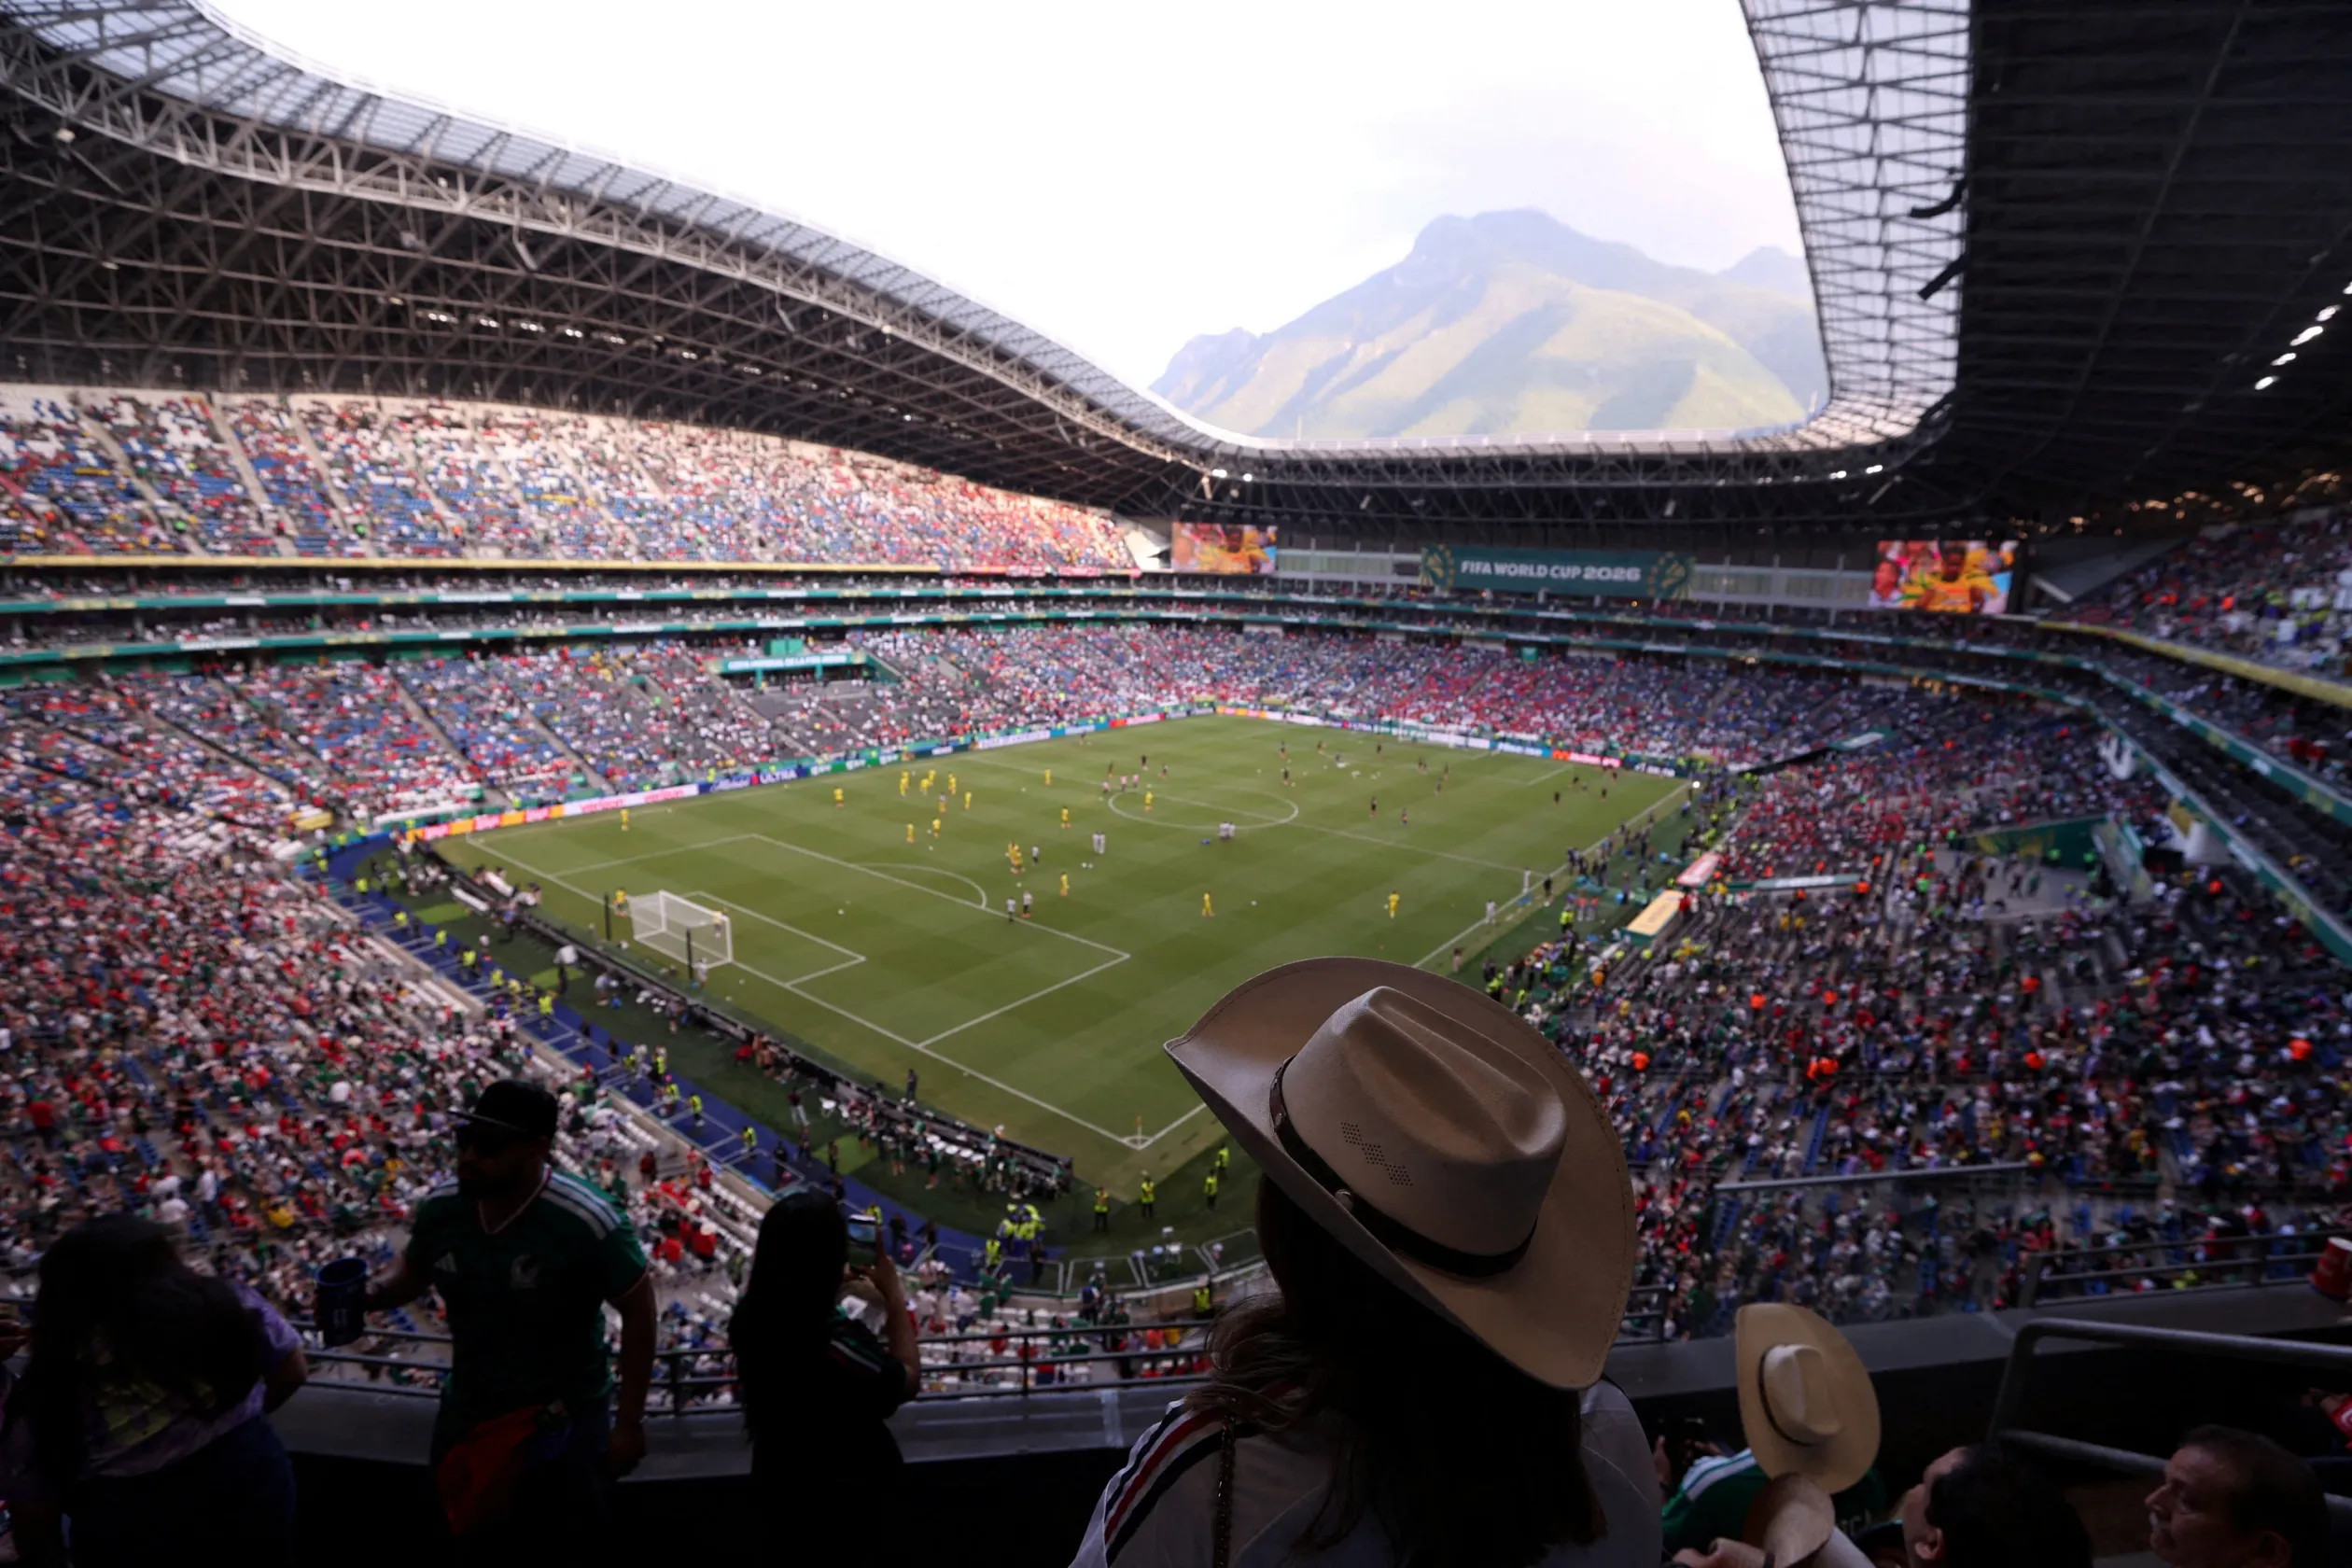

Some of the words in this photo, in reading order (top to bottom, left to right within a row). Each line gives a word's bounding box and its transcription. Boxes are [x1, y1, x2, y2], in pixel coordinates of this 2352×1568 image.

[1461, 560, 1492, 575] FIFA
[1494, 562, 1548, 578] WORLD
[1549, 565, 1582, 580] CUP
[1583, 566, 1642, 581] 2026
[759, 769, 797, 785] ULTRA
